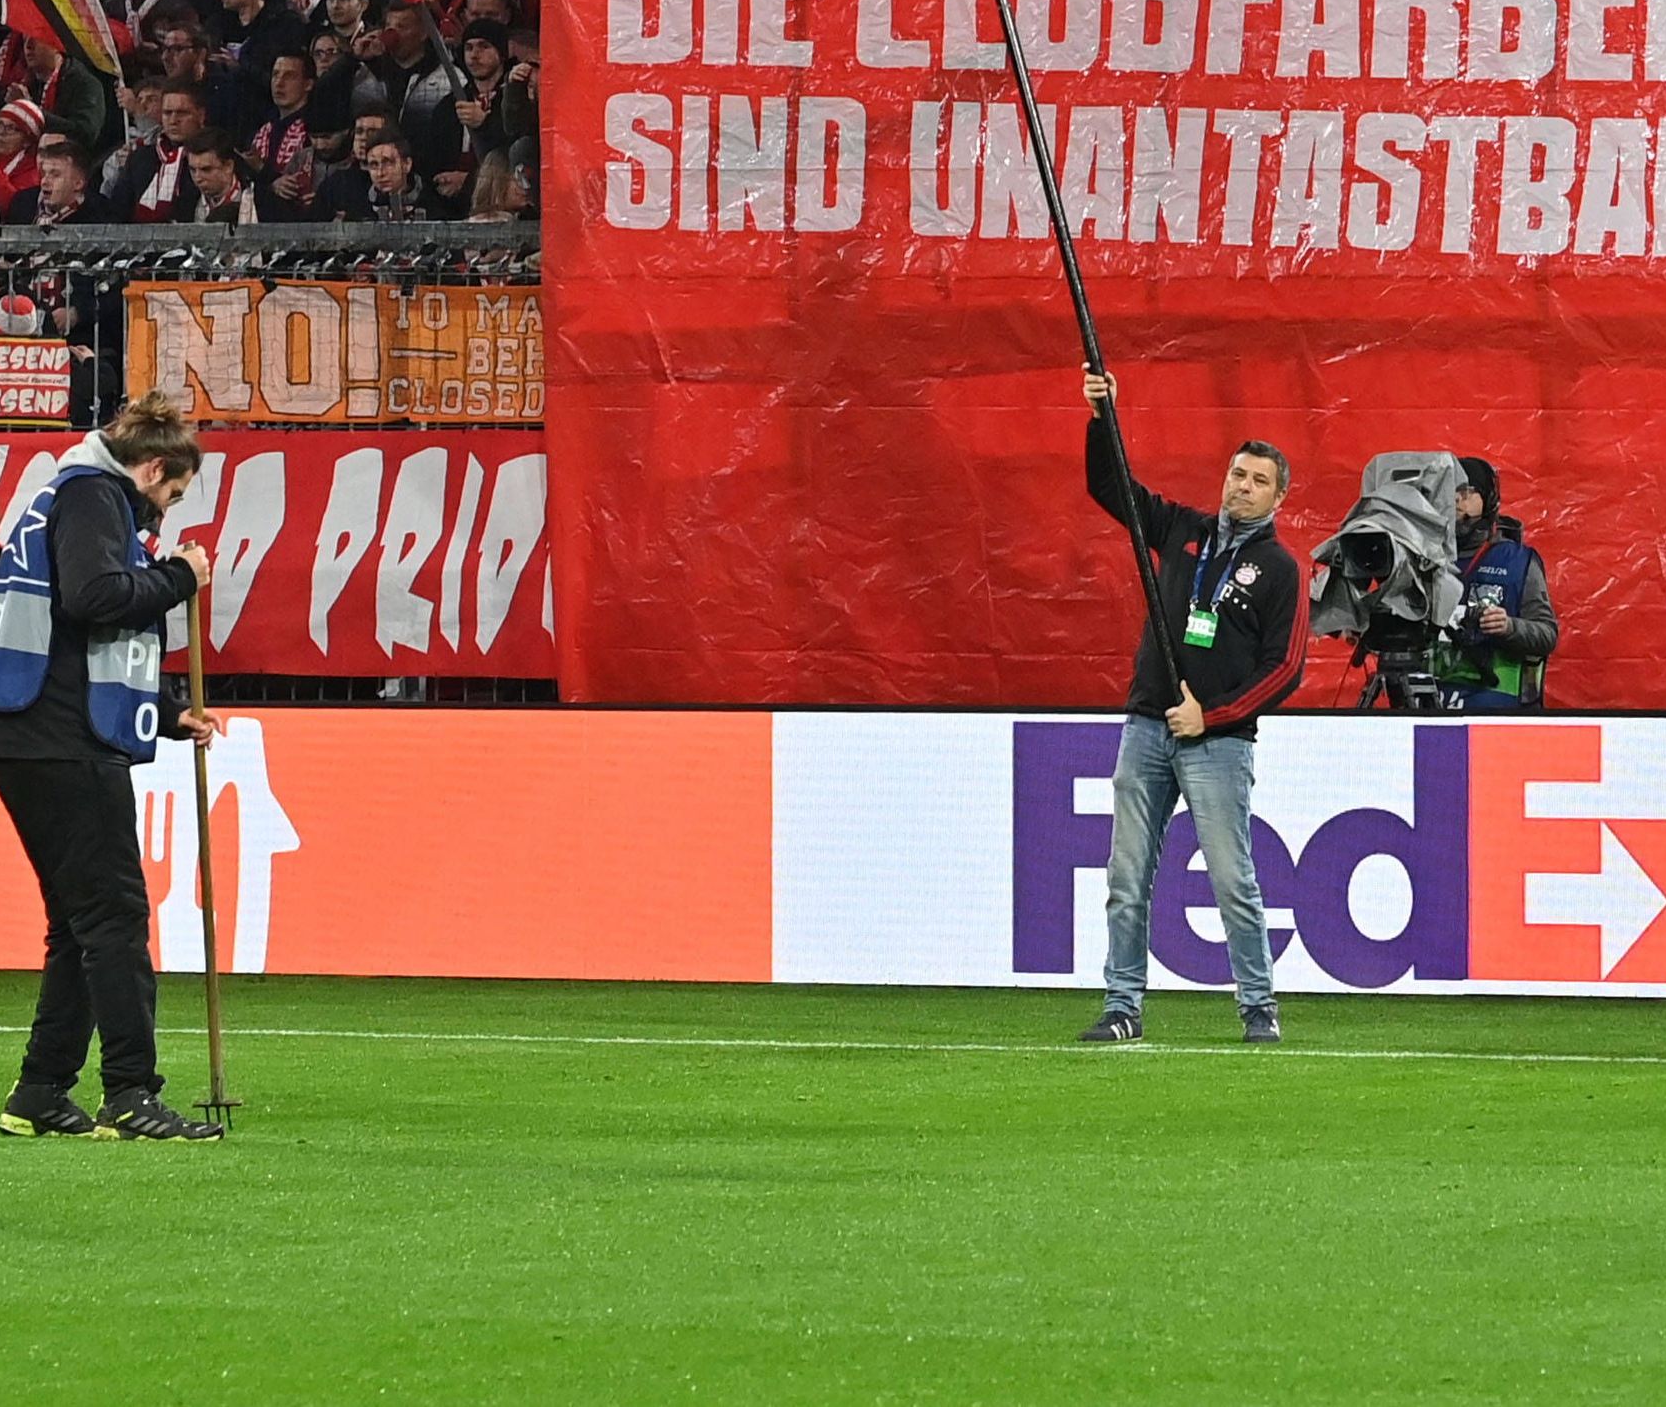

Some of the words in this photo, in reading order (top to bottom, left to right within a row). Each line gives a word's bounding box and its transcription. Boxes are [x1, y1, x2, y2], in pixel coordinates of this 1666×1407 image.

[603, 92, 867, 235] SIND
[144, 284, 381, 418] NO!
[387, 291, 450, 331] TO
[387, 377, 545, 419] CLOSED
[308, 446, 557, 660] PRID
